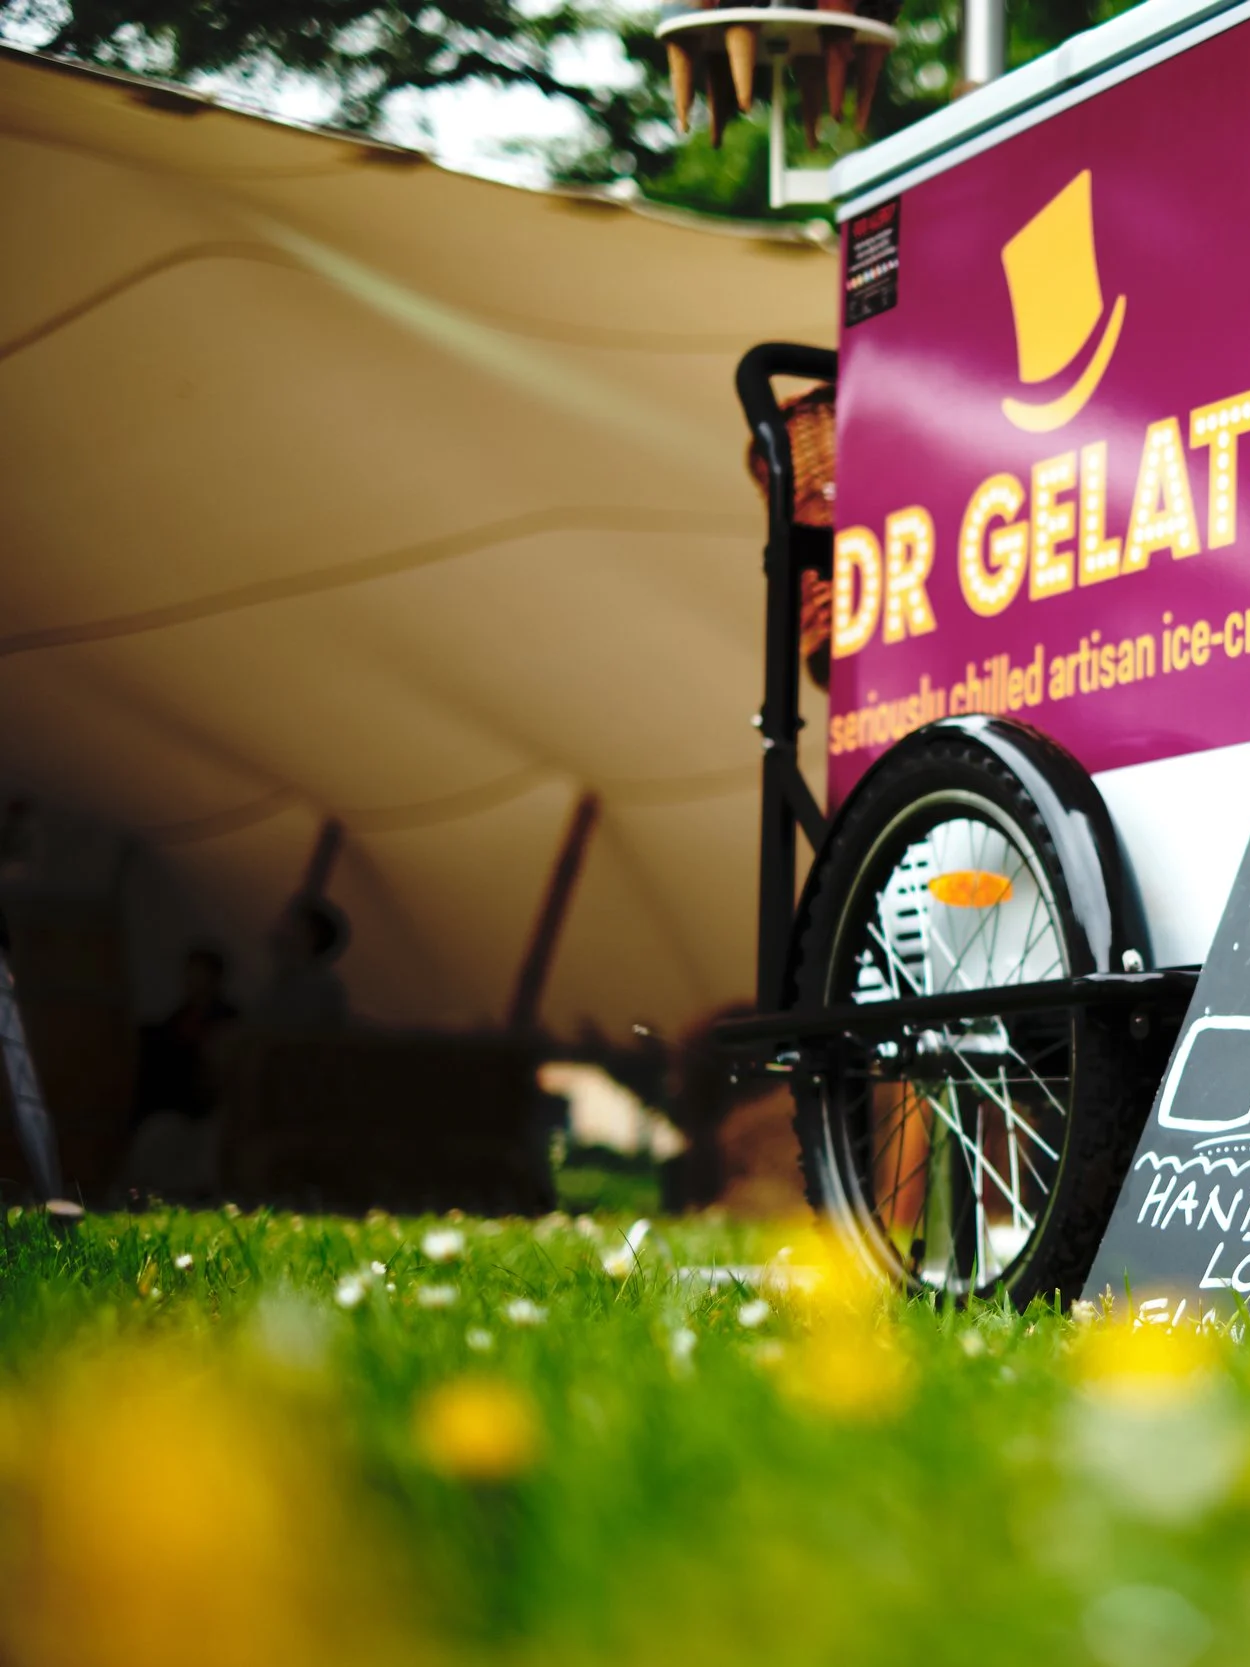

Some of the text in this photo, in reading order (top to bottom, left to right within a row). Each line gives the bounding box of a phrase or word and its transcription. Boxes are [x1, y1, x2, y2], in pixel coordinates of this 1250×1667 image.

[831, 504, 938, 660] DR
[830, 673, 946, 756] seriously
[949, 643, 1045, 715] chilled
[1048, 630, 1156, 700] artisan
